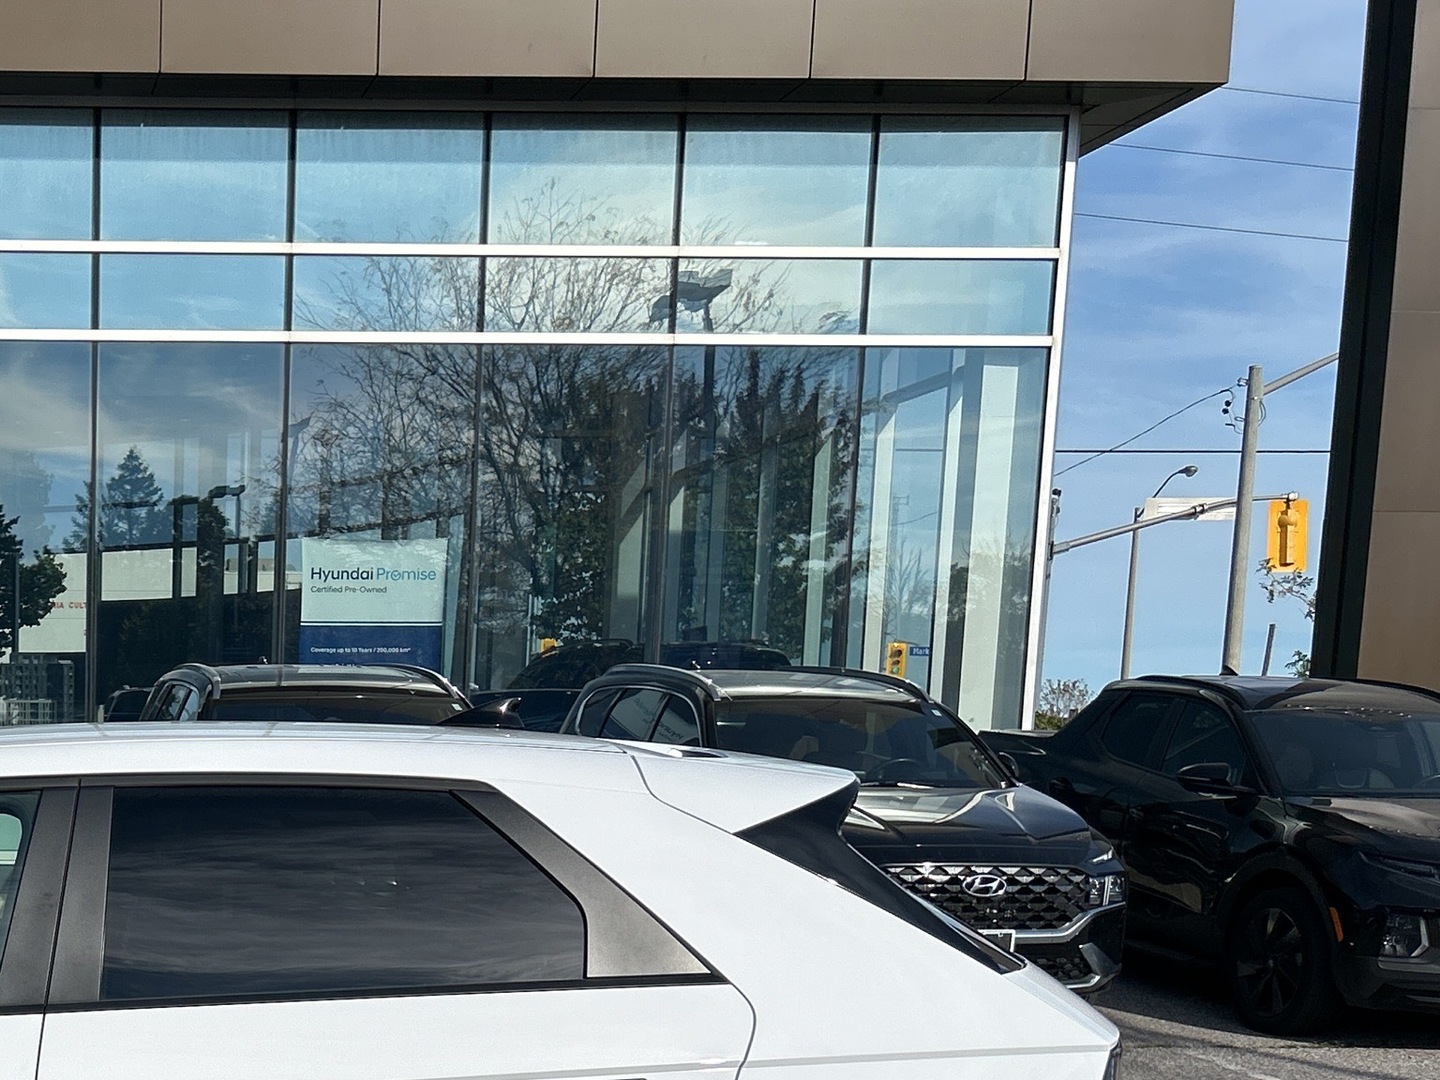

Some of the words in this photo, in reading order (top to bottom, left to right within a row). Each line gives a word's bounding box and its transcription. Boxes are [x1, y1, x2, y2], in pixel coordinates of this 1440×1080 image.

[310, 567, 374, 583] Hyundai
[376, 567, 437, 581] Promise
[310, 585, 343, 594] Certified
[344, 585, 388, 594] Pre-Owned
[310, 646, 336, 654] Coverage
